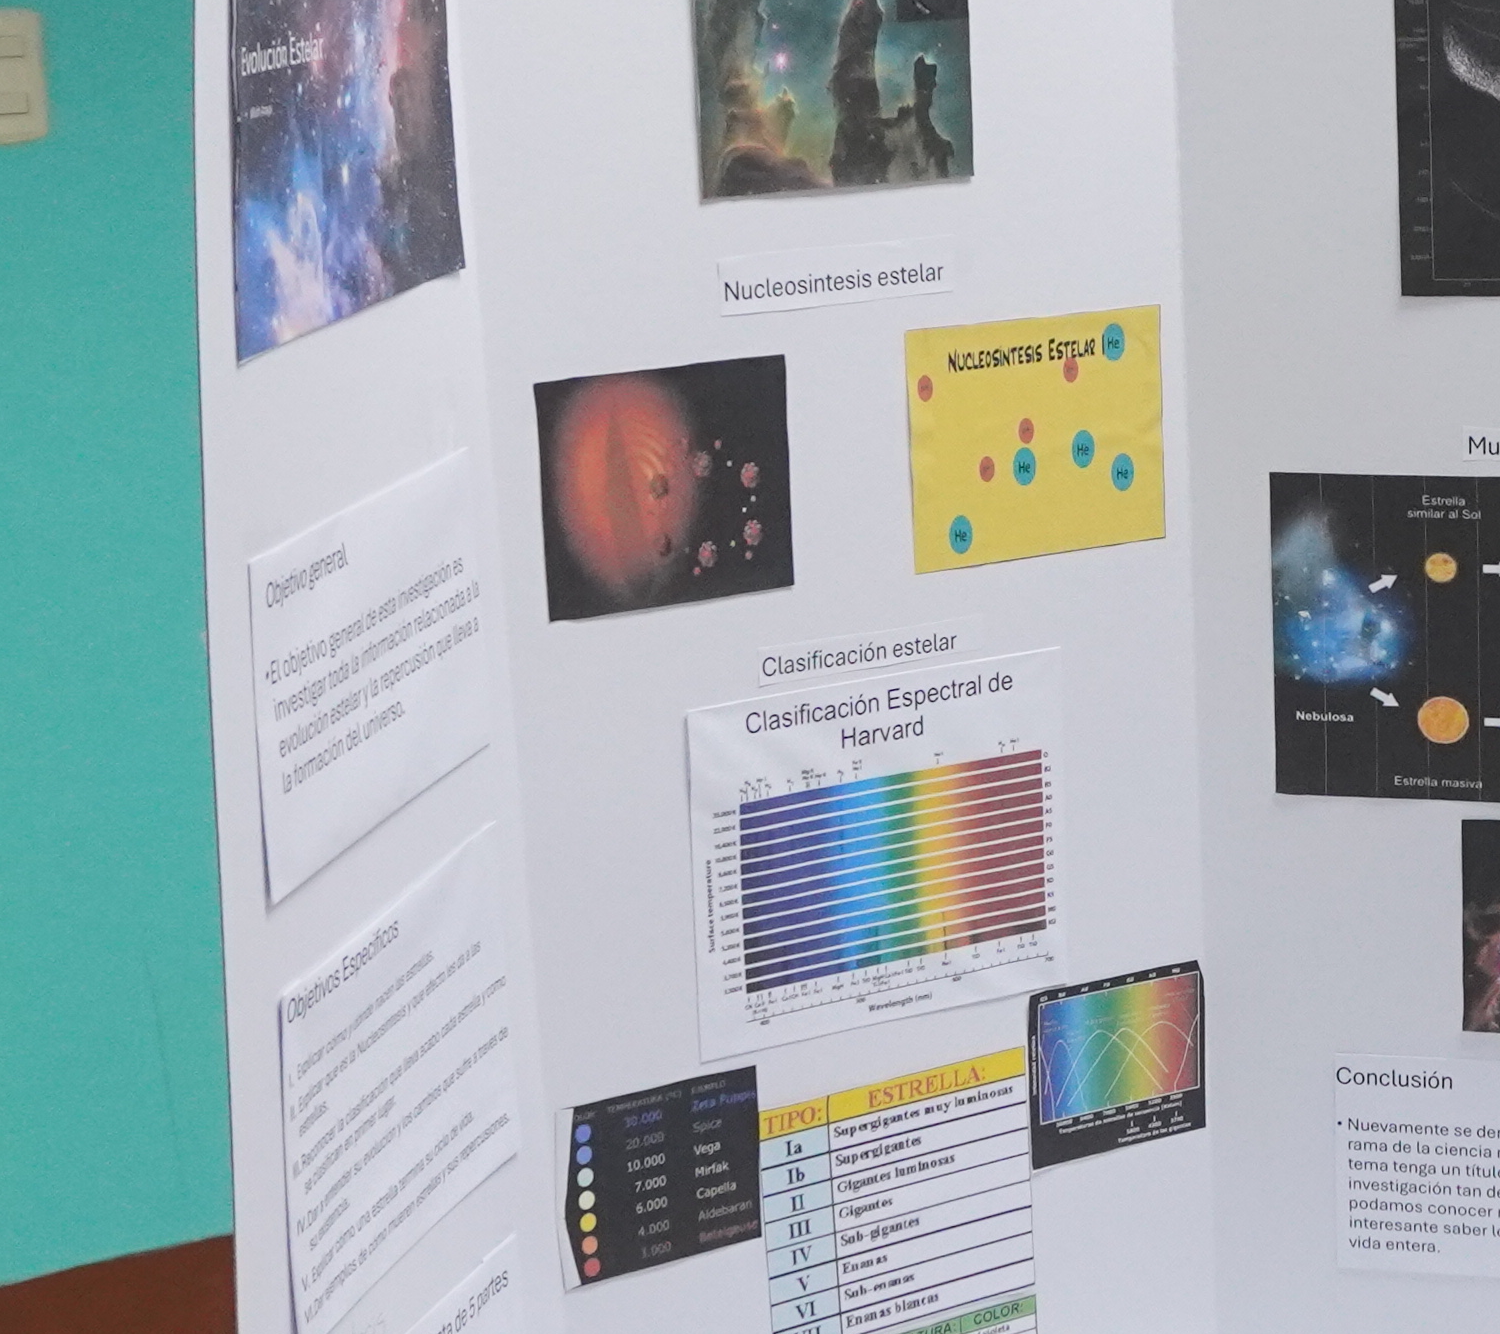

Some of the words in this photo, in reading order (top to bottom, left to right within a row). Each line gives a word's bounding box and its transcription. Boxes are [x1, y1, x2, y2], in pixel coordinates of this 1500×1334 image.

[241, 38, 288, 76] Evolución
[290, 32, 324, 65] Estelar
[724, 270, 872, 302] Nucleosintesis
[878, 263, 944, 287] estelar
[1107, 337, 1119, 349] He
[1018, 461, 1031, 473] He
[1077, 444, 1089, 457] He
[1116, 468, 1128, 480] He
[1407, 508, 1445, 519] similar
[1449, 509, 1457, 519] al
[1462, 509, 1481, 520] Sol
[1422, 495, 1465, 507] Estrella
[955, 529, 967, 541] He
[265, 569, 307, 608] Objetivo
[309, 542, 348, 590] general
[762, 642, 887, 677] Clasificación
[892, 633, 957, 658] estelar
[745, 694, 880, 734] Clasificación
[887, 674, 982, 710] Espectral
[988, 671, 1013, 692] de
[1296, 711, 1354, 722] Nebulosa
[841, 715, 924, 749] Harvard
[1394, 776, 1438, 788] Estrella
[1441, 778, 1483, 789] masiva
[705, 859, 715, 920] temperature
[706, 919, 716, 954] Surface
[287, 970, 340, 1023] Objetivos
[342, 920, 399, 982] Específicos
[1336, 1067, 1453, 1089] Conclusión
[764, 1106, 822, 1135] TIPO:
[868, 1065, 985, 1108] ESTRELLA:
[785, 1140, 803, 1157] Ia
[833, 1107, 920, 1139] Supergigantes
[925, 1101, 950, 1115] muy
[954, 1084, 1014, 1107] luminosas
[1348, 1118, 1449, 1136] Nuevamente
[1454, 1126, 1472, 1137] se
[627, 1153, 665, 1173] 10.000
[694, 1141, 721, 1156] Vega
[787, 1168, 805, 1185] Ib
[835, 1135, 922, 1167] Supergigantes
[1348, 1140, 1388, 1152] rama
[1392, 1140, 1411, 1154] de
[1417, 1141, 1430, 1155] la
[1435, 1143, 1492, 1158] ciencia
[634, 1174, 667, 1193] 7.000
[695, 1160, 729, 1178] Mirfak
[790, 1193, 805, 1213] II
[837, 1170, 891, 1193] Gigantes
[895, 1153, 955, 1178] luminosas
[1348, 1158, 1388, 1171] tema
[1393, 1160, 1436, 1178] tenga
[1442, 1165, 1460, 1176] un
[635, 1196, 668, 1214] 6.000
[696, 1181, 737, 1199] Capella
[1349, 1177, 1451, 1195] investigación
[1457, 1185, 1482, 1197] tan
[788, 1219, 812, 1240] III
[839, 1197, 893, 1219] Gigantes
[1349, 1198, 1422, 1214] podamos
[1428, 1204, 1493, 1218] conocer
[791, 1245, 812, 1266] IV
[840, 1216, 920, 1246] Sub-gigantes
[1350, 1216, 1438, 1234] interesante
[1444, 1223, 1487, 1237] saber
[1349, 1236, 1380, 1250] vida
[1386, 1239, 1440, 1253] entera.
[798, 1274, 811, 1292] V
[842, 1254, 888, 1274] Enanas
[455, 1307, 467, 1333] de
[469, 1297, 475, 1319] 5
[477, 1270, 509, 1316] partes
[795, 1300, 817, 1320] VI
[844, 1273, 915, 1300] Sub-enanas
[845, 1306, 891, 1328] Enanas
[895, 1292, 939, 1313] blancas
[973, 1302, 1024, 1325] COLOR:
